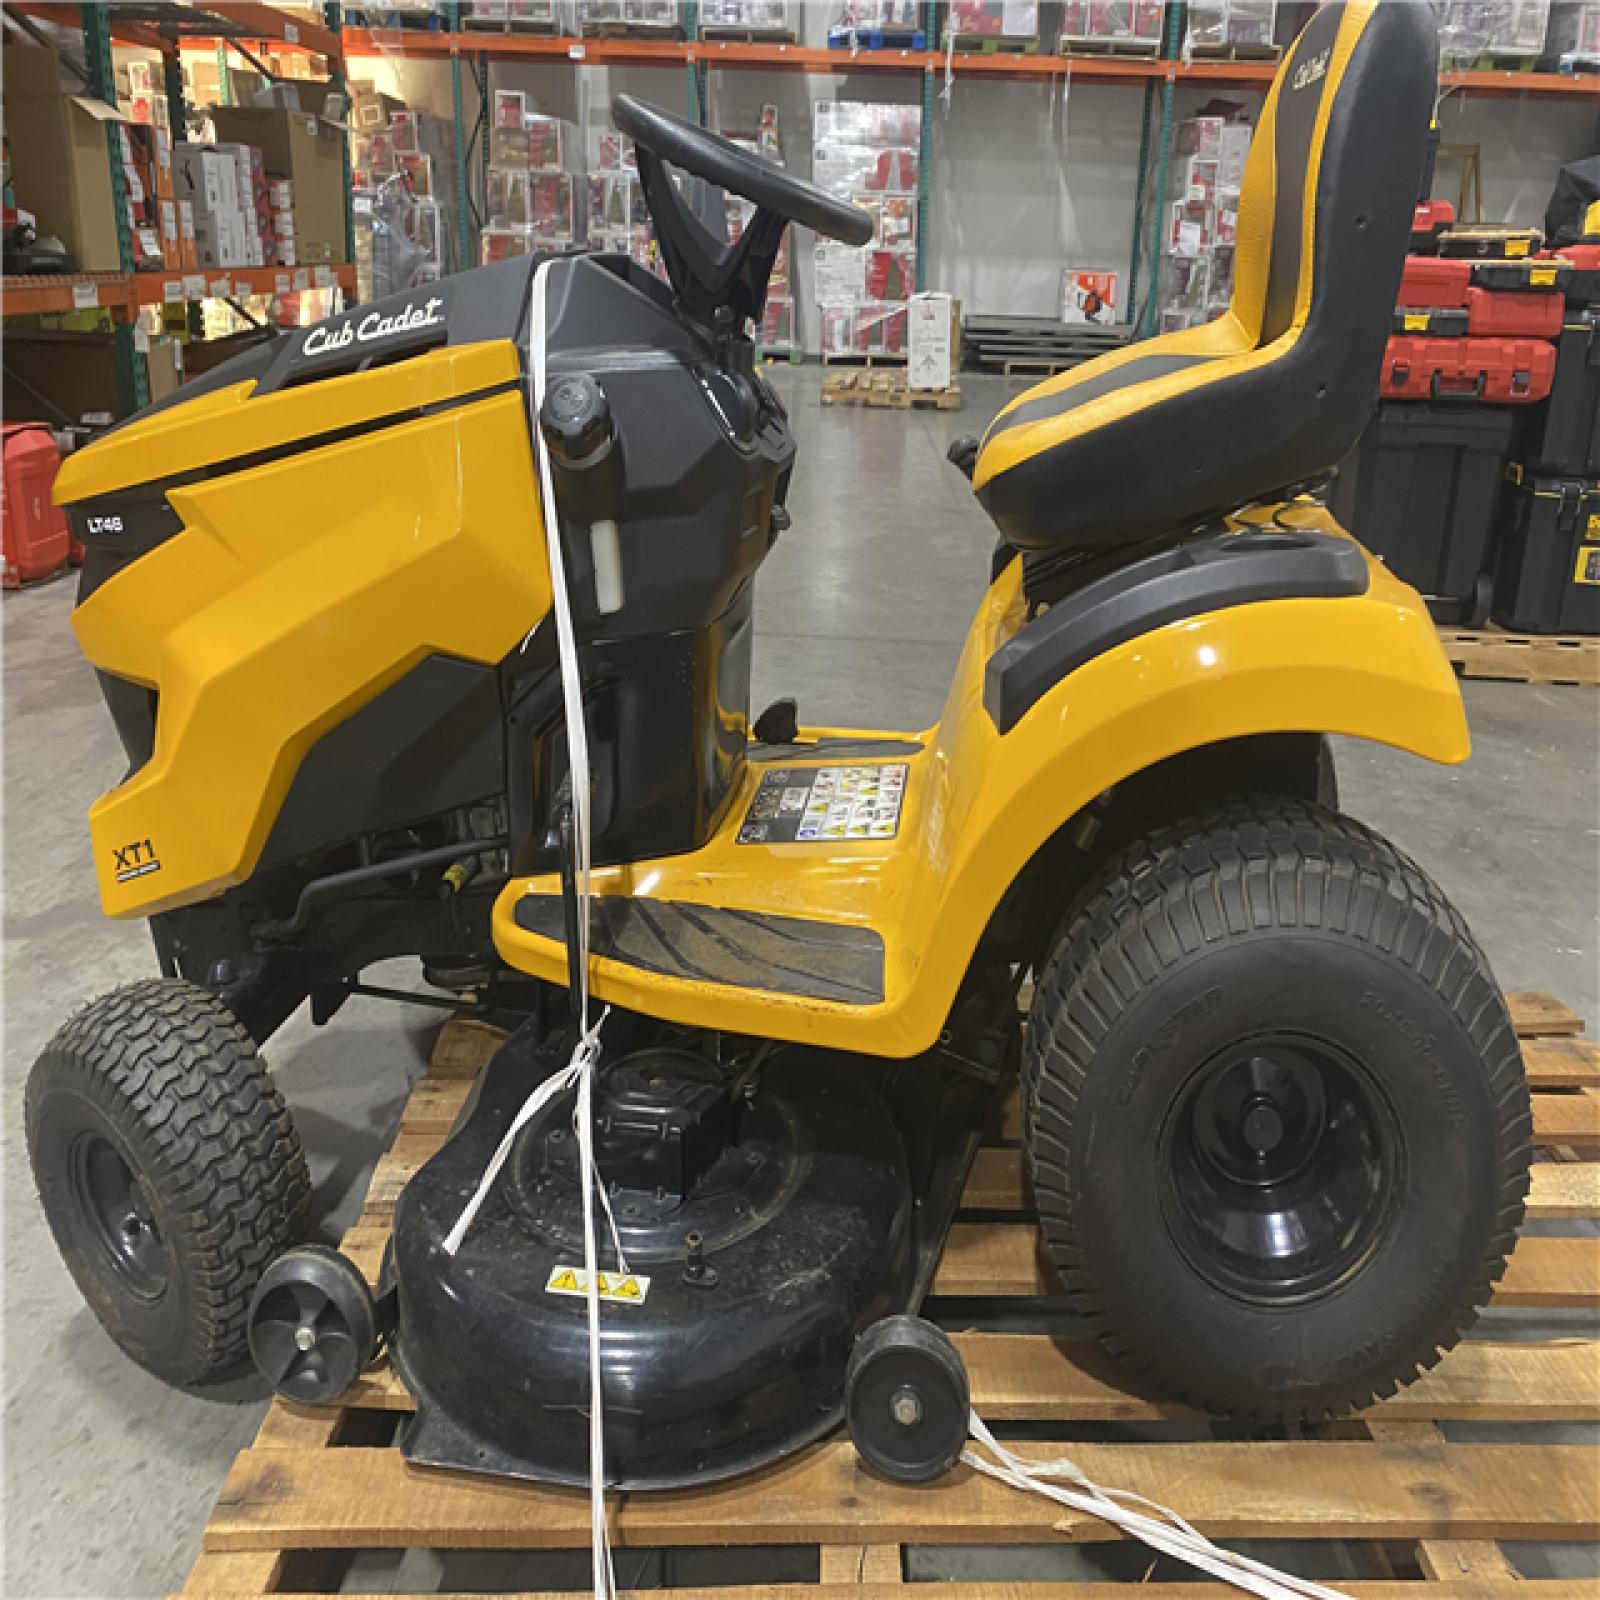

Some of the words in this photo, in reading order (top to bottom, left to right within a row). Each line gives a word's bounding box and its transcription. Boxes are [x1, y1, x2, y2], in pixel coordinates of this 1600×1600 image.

[302, 322, 354, 356] Cub
[357, 297, 443, 341] Cadet
[112, 837, 155, 871] XT1
